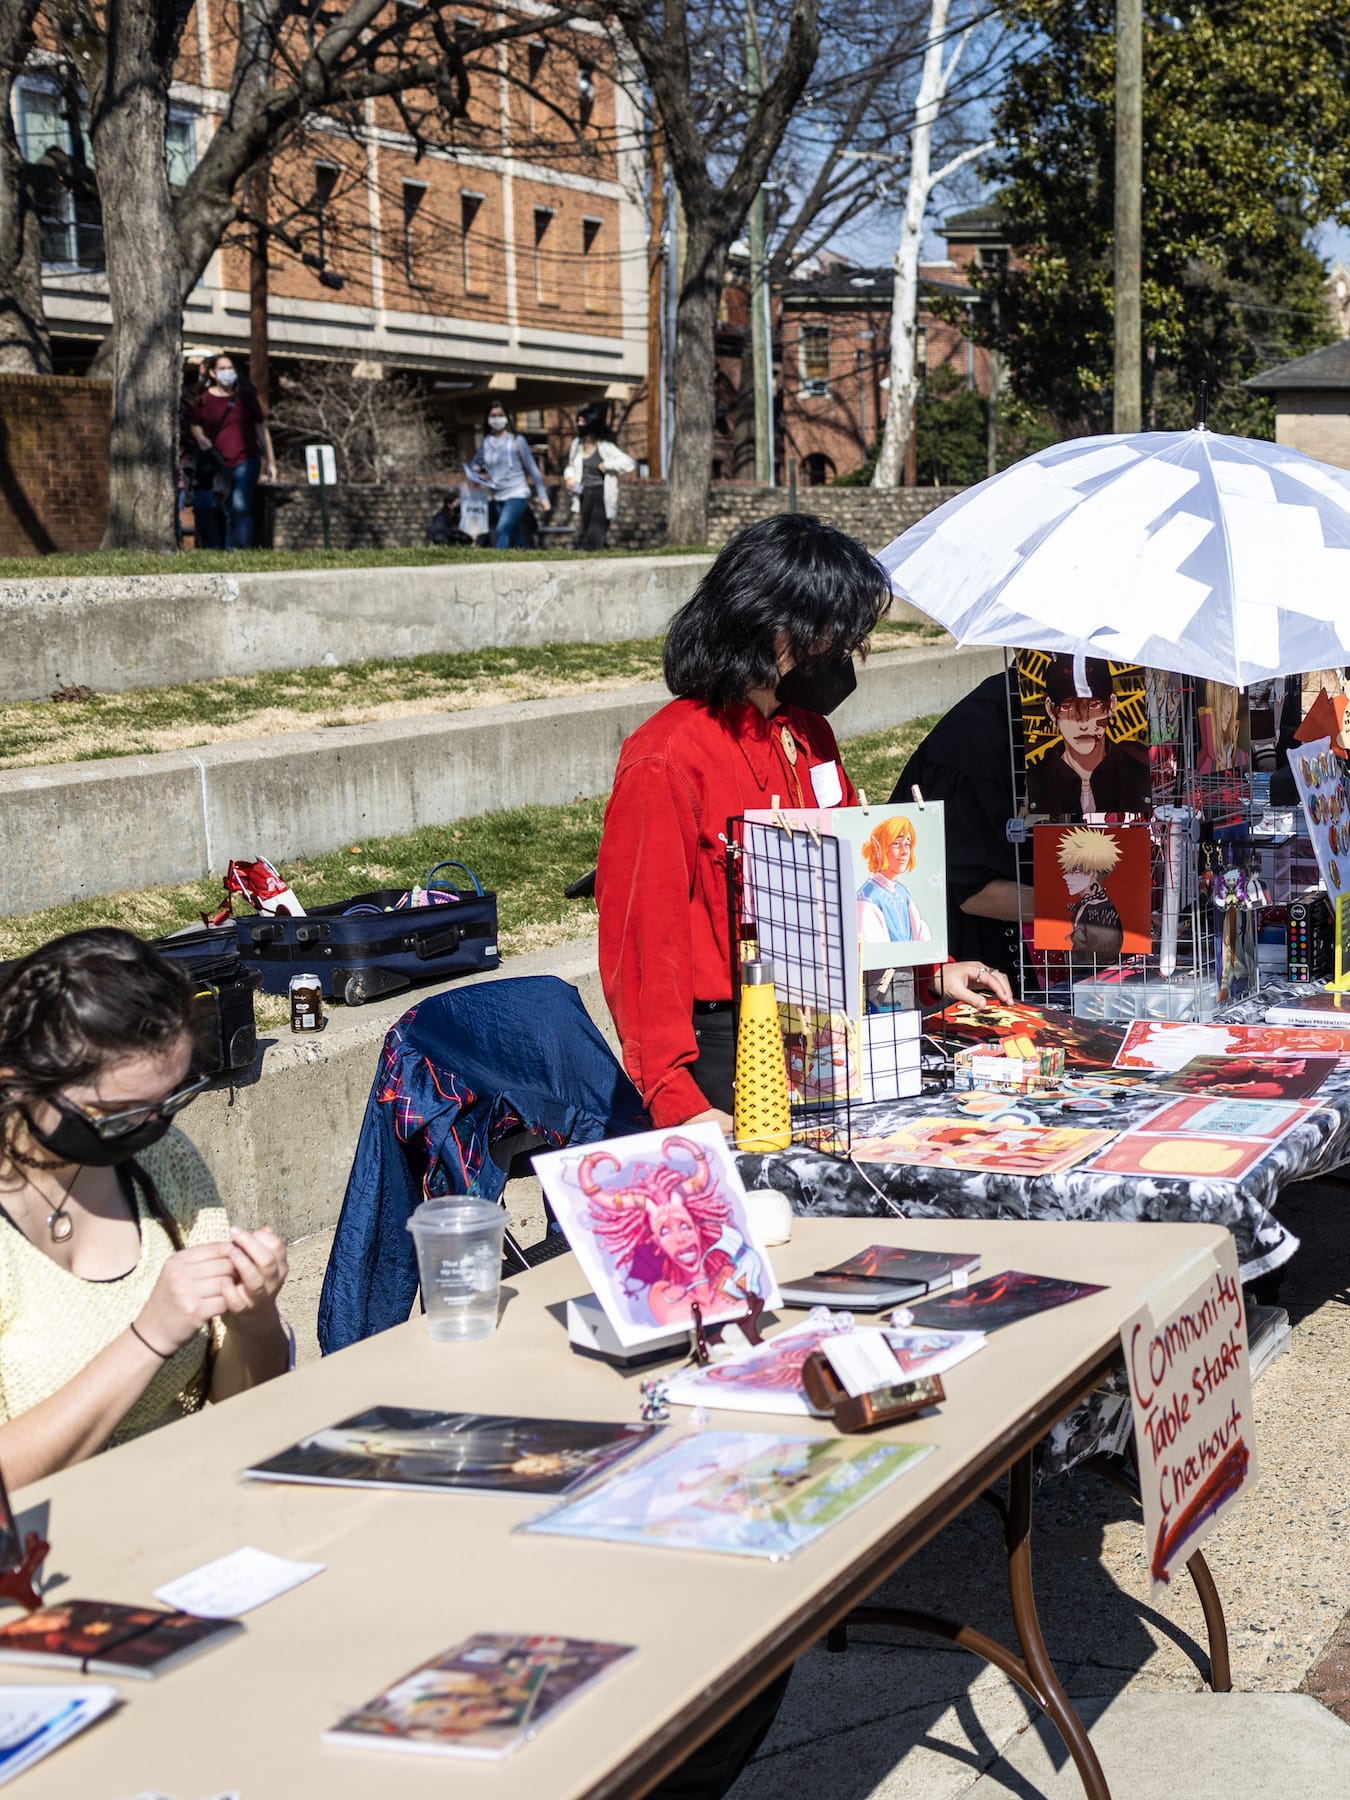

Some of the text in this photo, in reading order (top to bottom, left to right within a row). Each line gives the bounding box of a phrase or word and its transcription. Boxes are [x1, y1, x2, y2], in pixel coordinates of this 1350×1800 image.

[1131, 1273, 1242, 1409] Community
[1144, 1392, 1191, 1466] Table
[1160, 1398, 1242, 1515] Checkout
